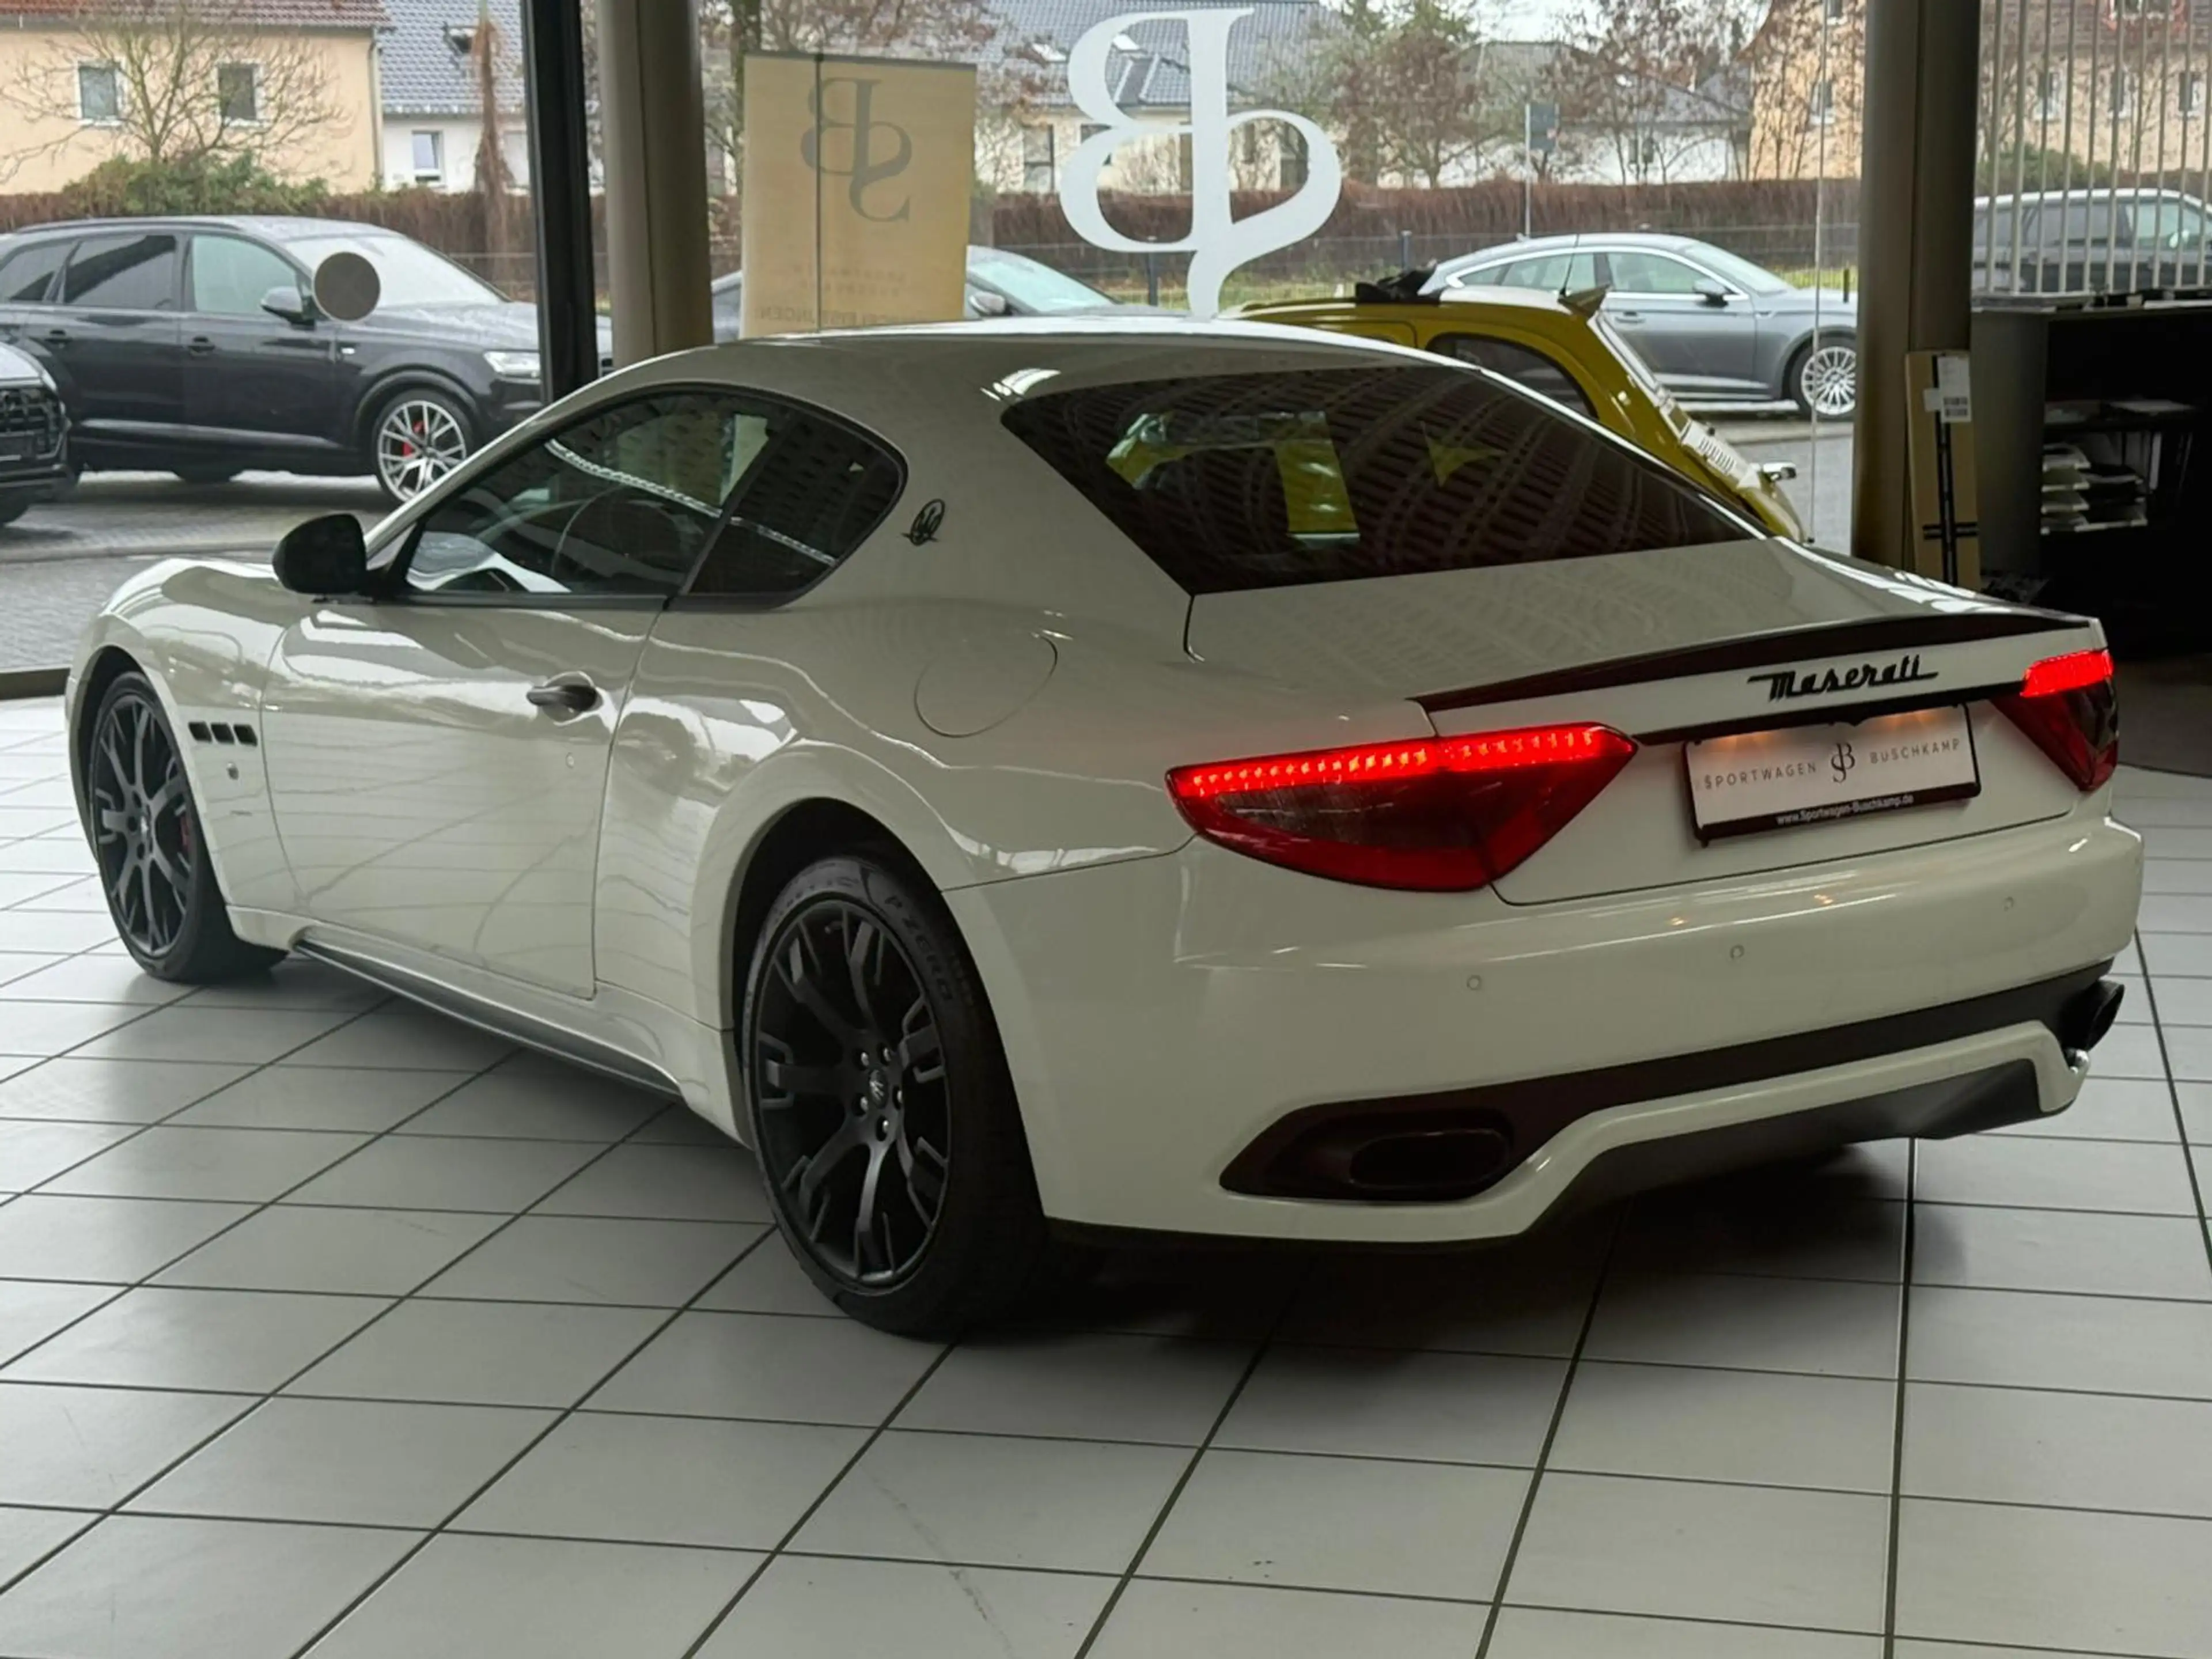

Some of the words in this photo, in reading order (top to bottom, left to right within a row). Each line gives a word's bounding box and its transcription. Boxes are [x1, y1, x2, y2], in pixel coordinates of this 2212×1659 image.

[1747, 654, 1939, 703] Maserati
[1703, 762, 1816, 790] SPORTWAGEN
[1869, 737, 1960, 764] BUSCHKAMP
